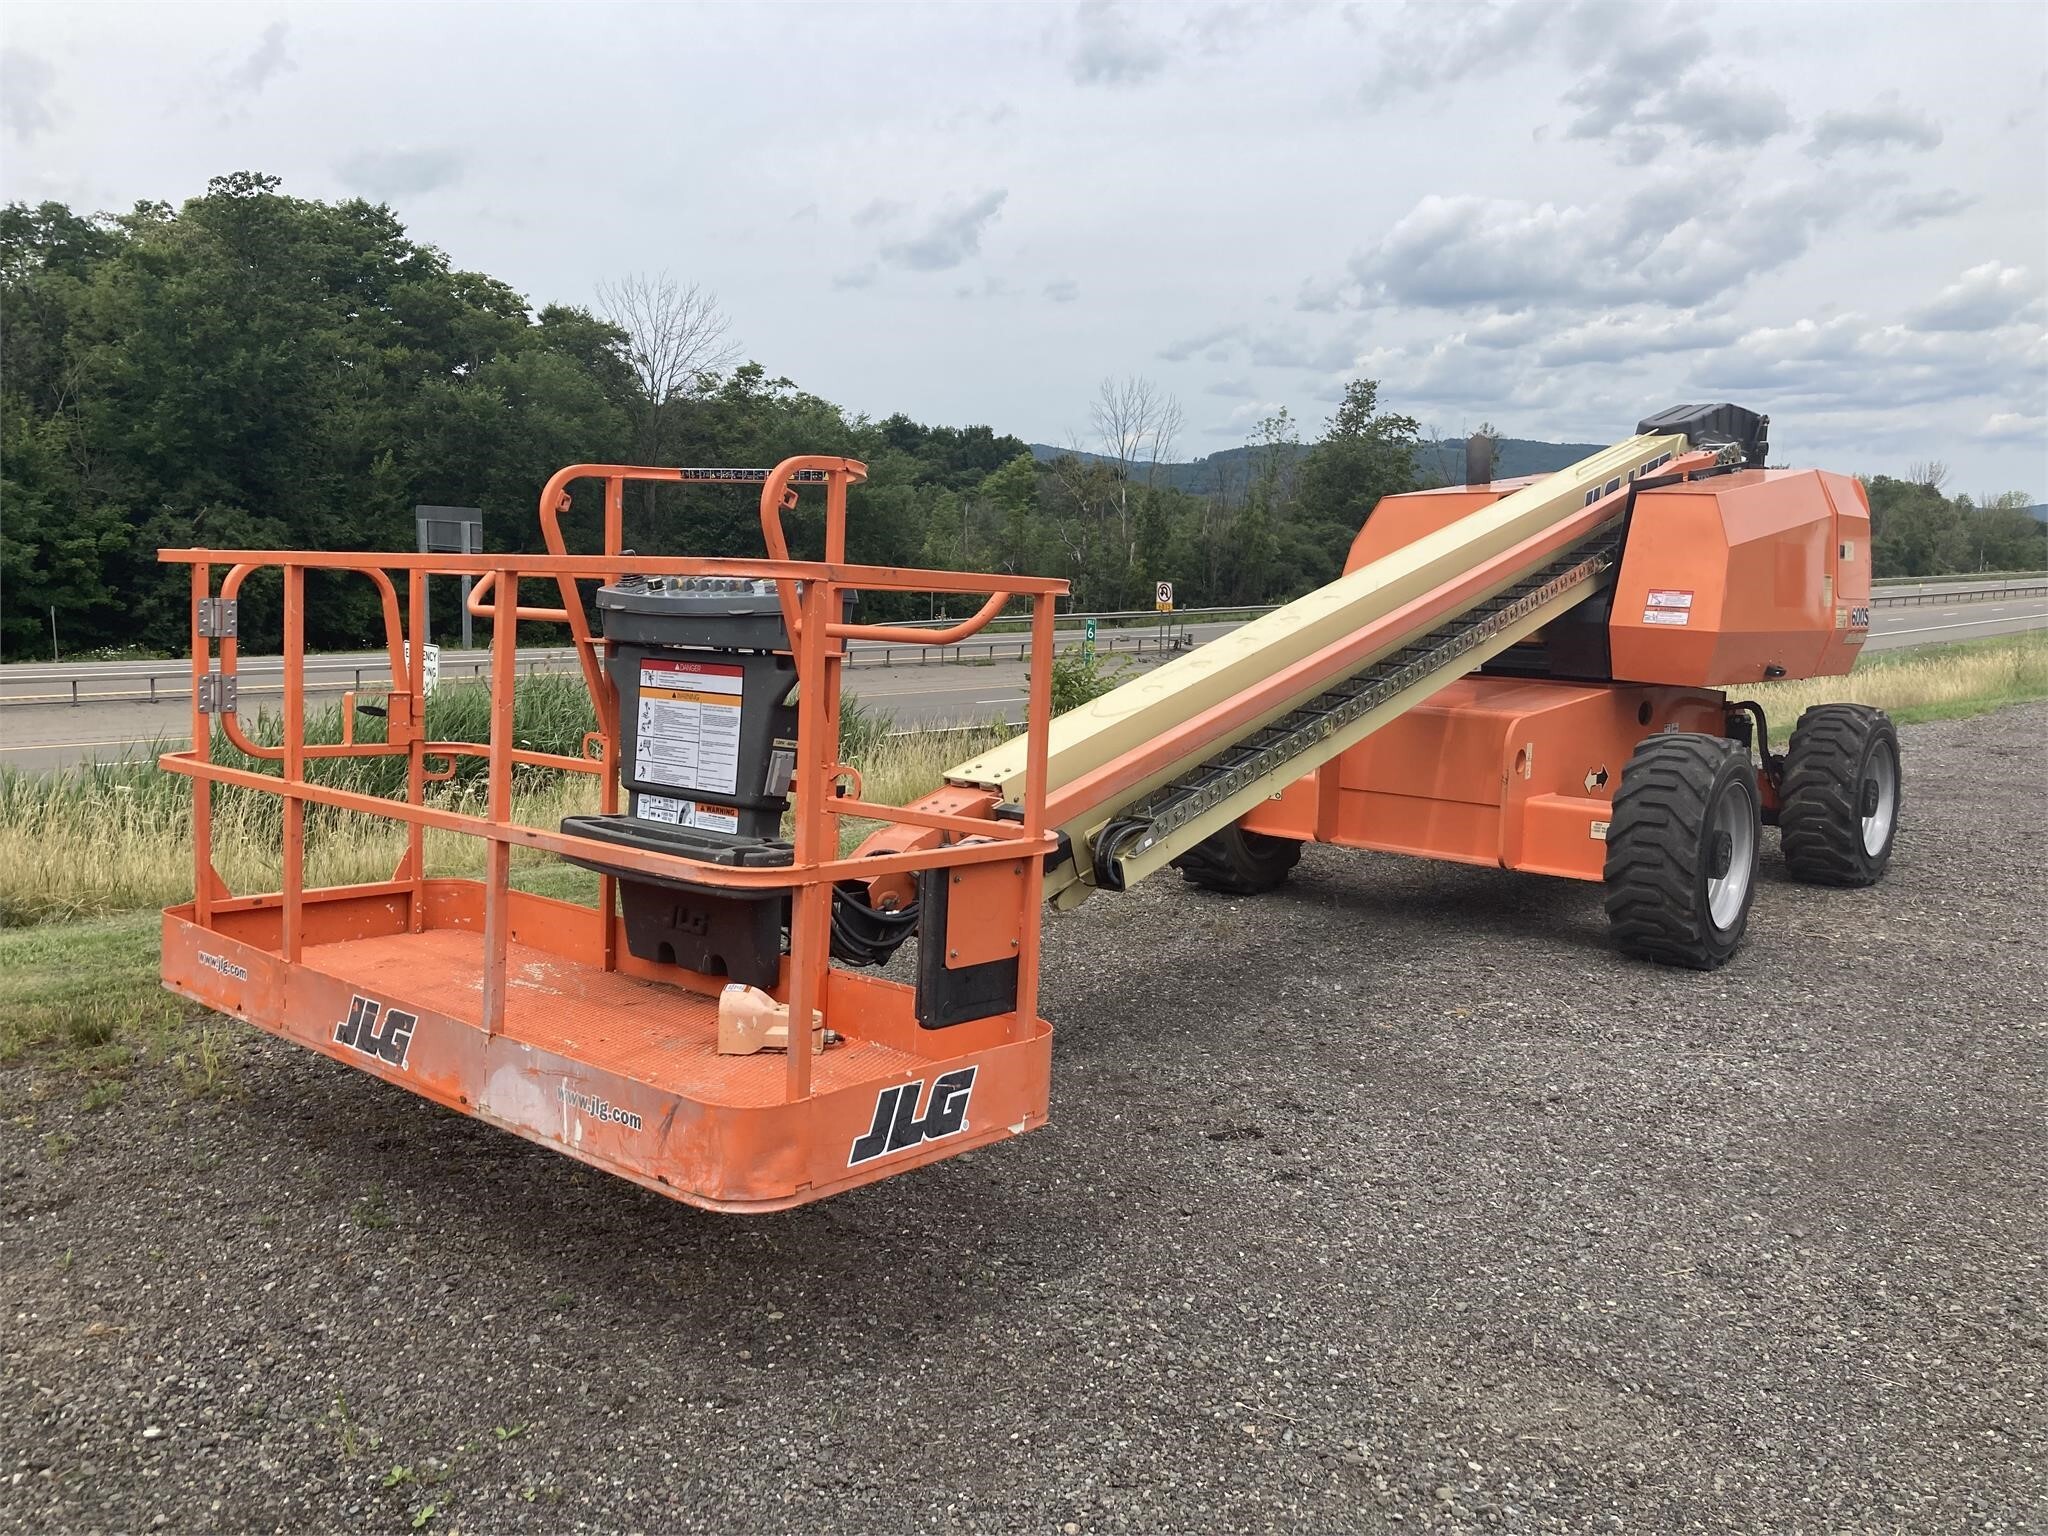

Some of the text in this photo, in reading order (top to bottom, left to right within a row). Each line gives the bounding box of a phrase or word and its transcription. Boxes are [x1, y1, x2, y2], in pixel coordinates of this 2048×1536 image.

[1851, 607, 1869, 627] 600S
[1087, 627, 1094, 639] 6
[680, 663, 701, 672] DANGER
[706, 805, 735, 817] WARNING
[198, 950, 248, 981] www.jlg.com
[333, 994, 418, 1067] JLG
[557, 1087, 642, 1131] www.jlg.com
[847, 1065, 979, 1168] JLG
